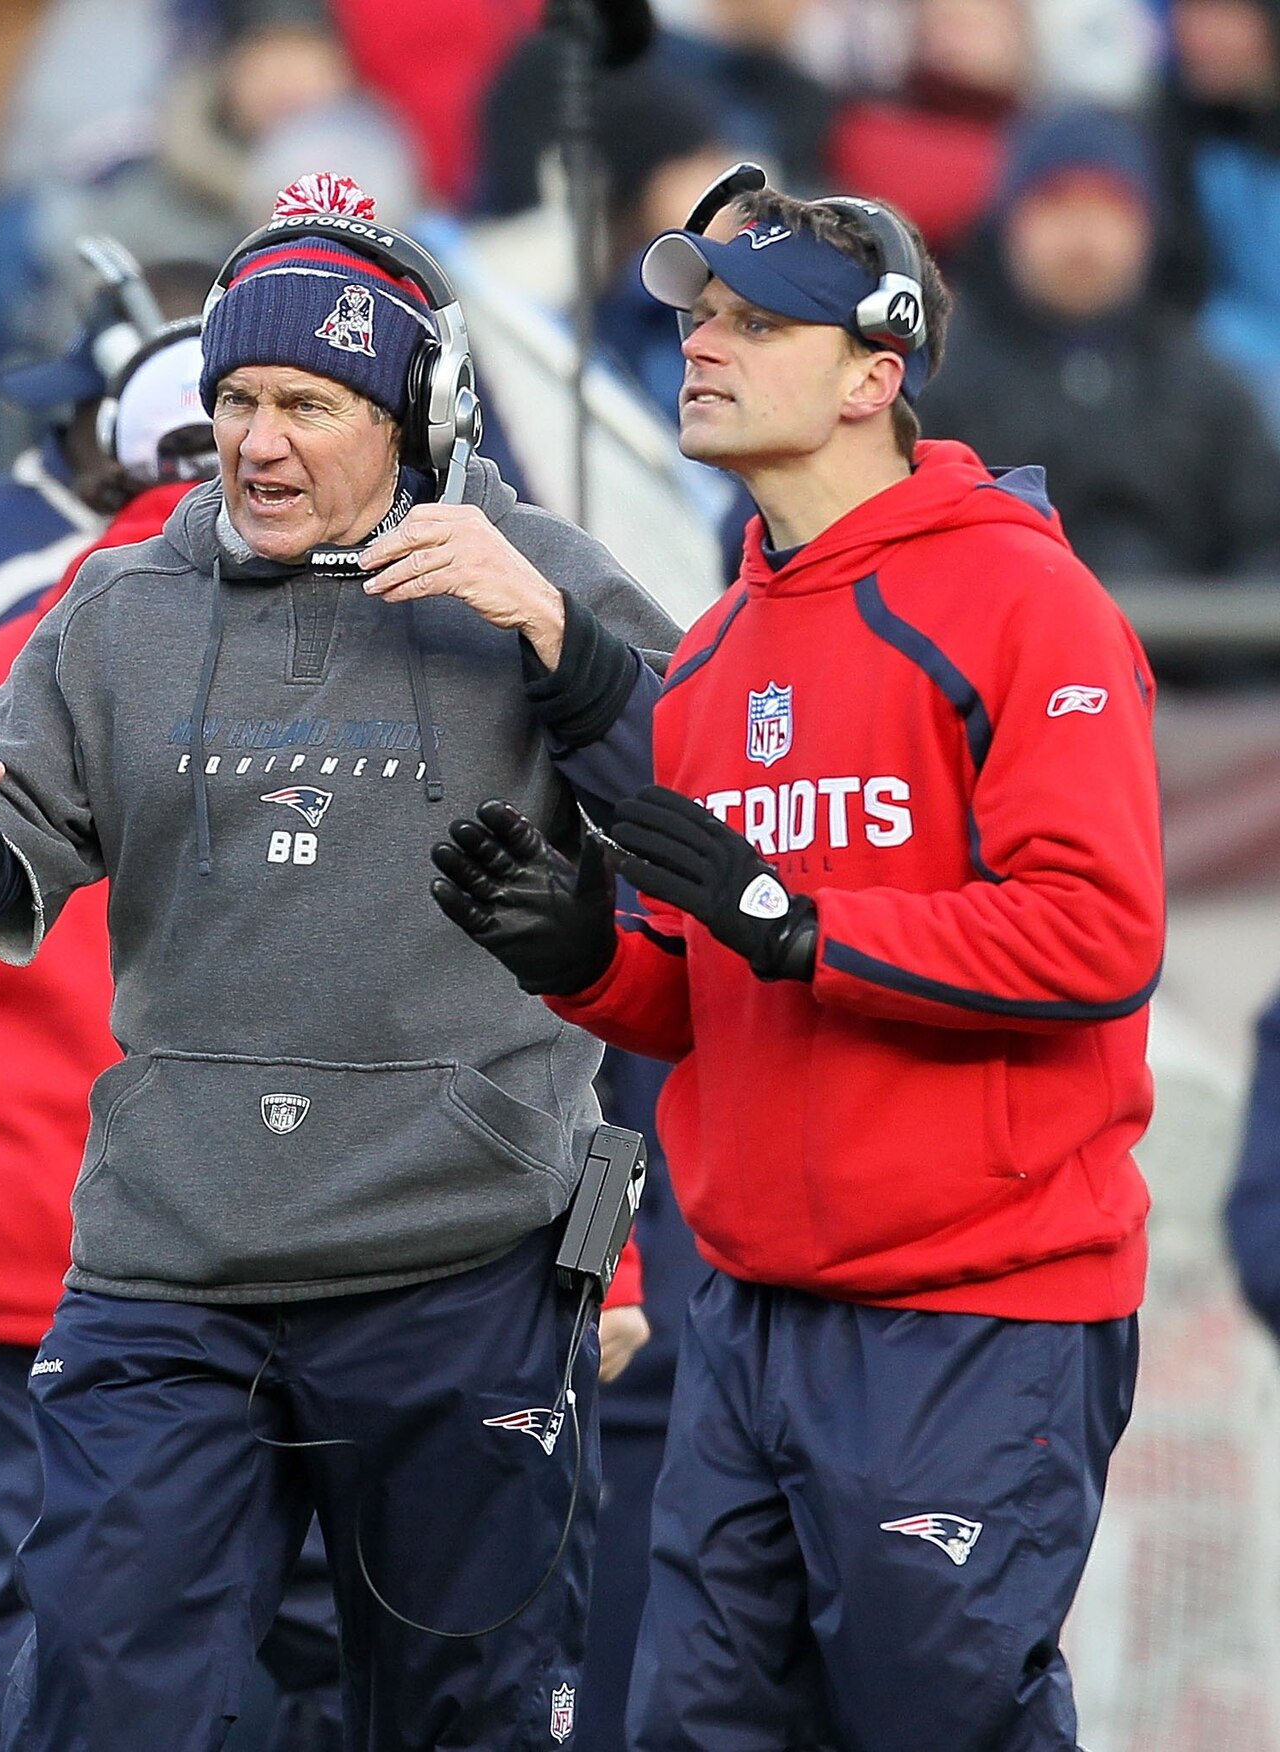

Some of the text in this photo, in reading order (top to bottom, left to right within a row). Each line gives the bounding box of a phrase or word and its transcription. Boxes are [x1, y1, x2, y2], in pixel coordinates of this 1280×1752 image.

[267, 215, 395, 248] MOTOROLA
[311, 552, 361, 565] MOTO
[751, 718, 787, 755] NFL
[694, 775, 914, 856] TRIOTS
[266, 830, 319, 865] BB
